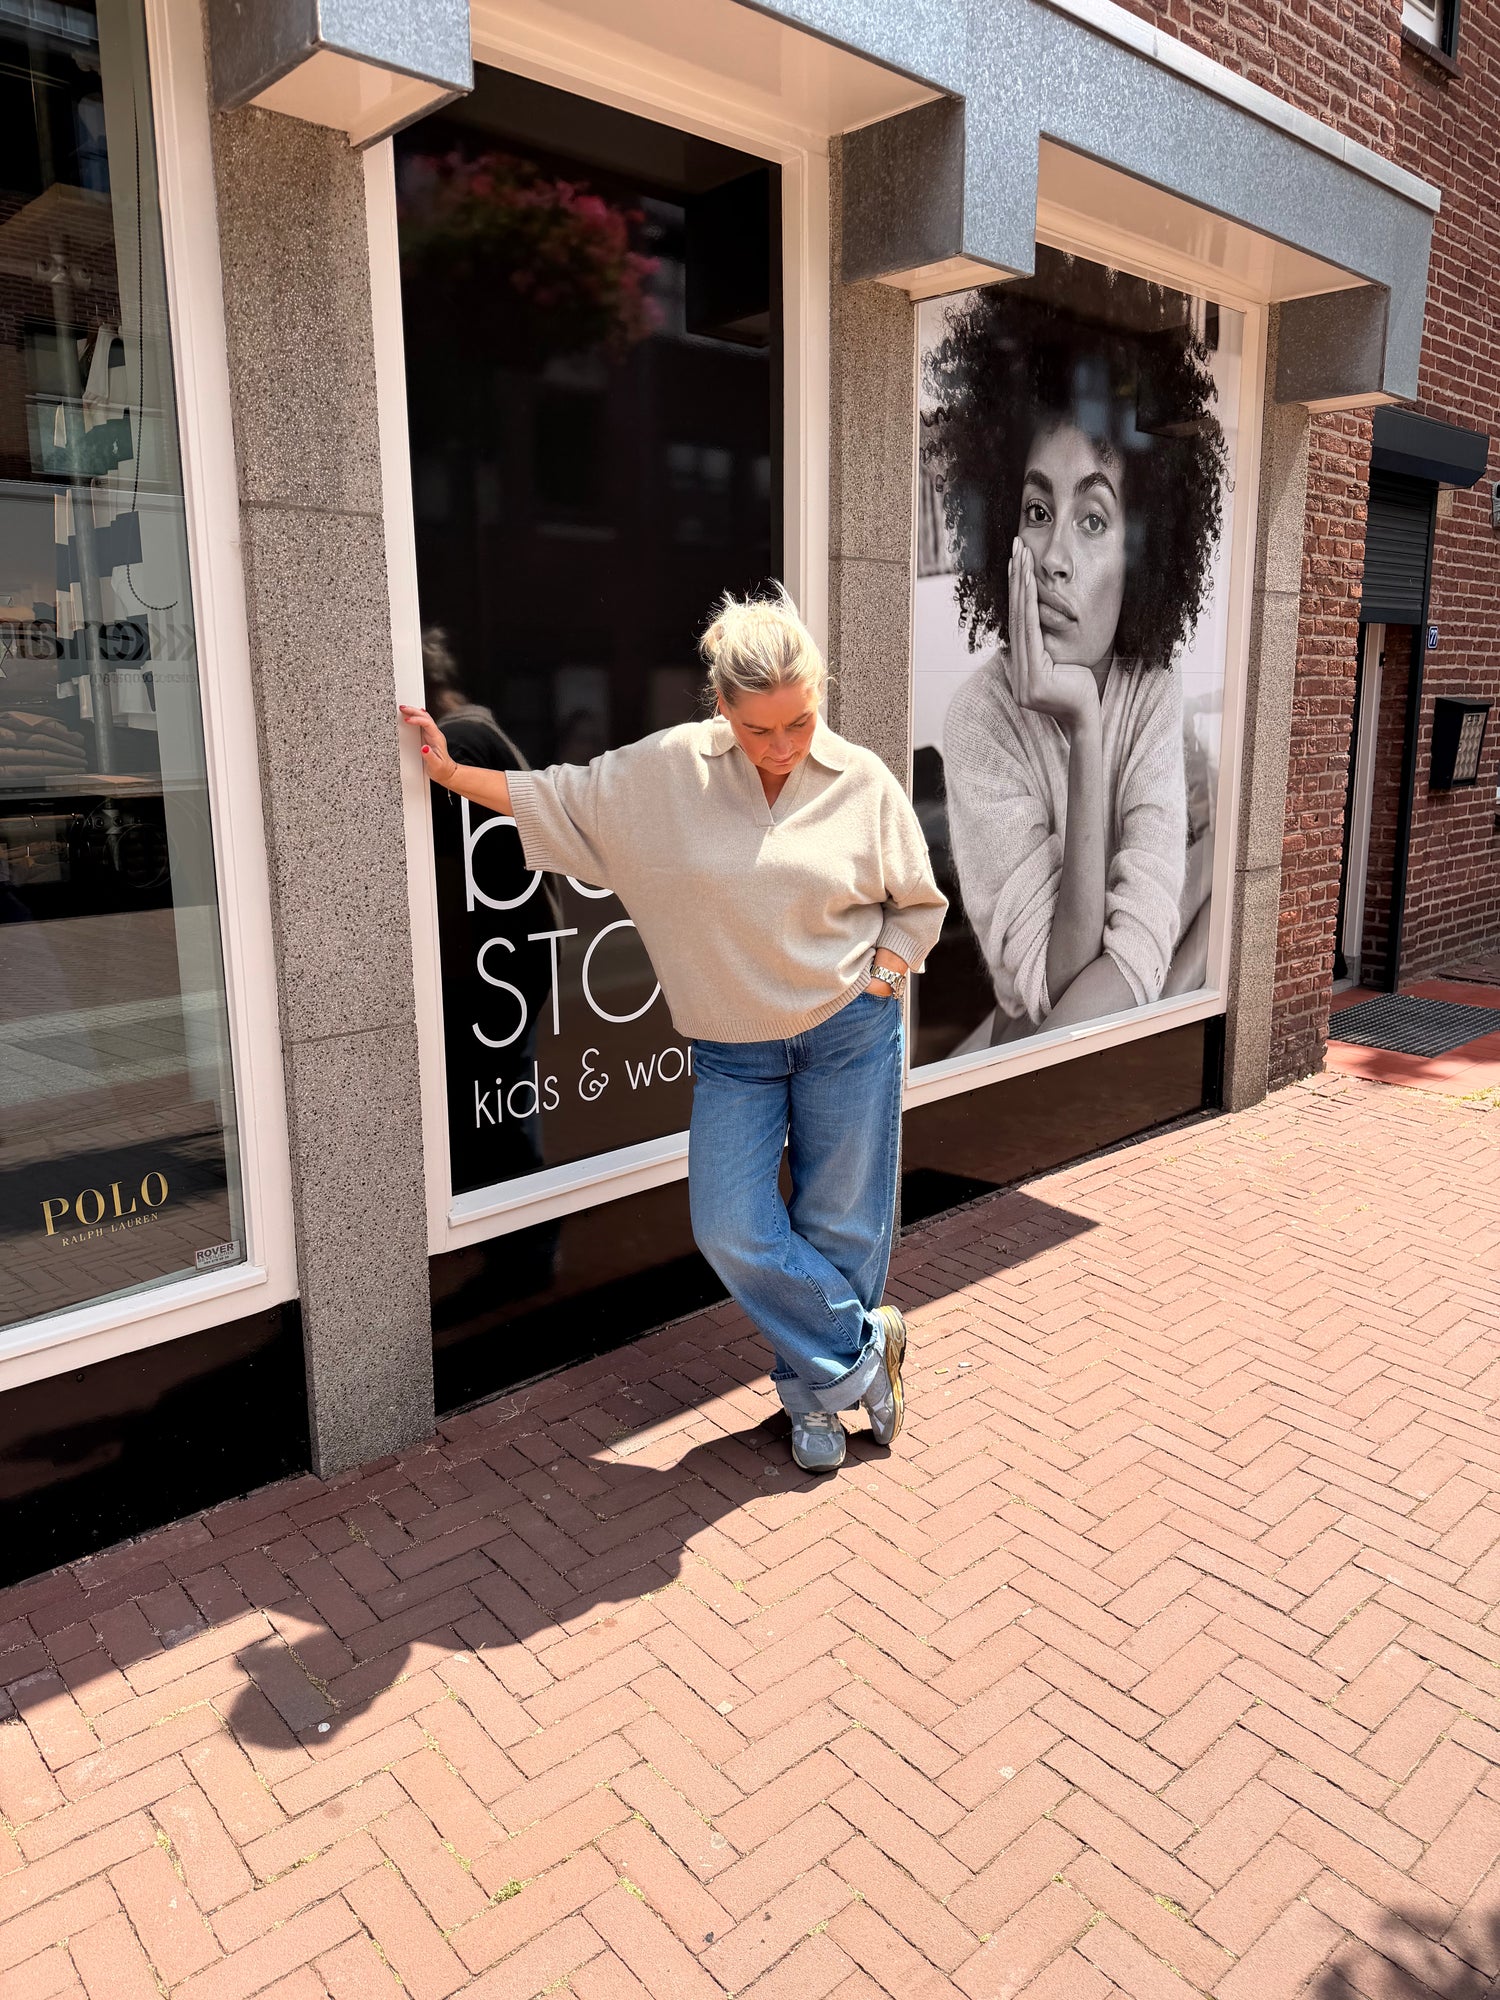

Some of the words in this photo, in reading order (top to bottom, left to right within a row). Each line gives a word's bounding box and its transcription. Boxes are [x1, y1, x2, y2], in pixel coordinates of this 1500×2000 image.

[1429, 629, 1438, 645] 77
[475, 1061, 560, 1129] kids
[578, 1048, 609, 1102] &
[40, 1171, 169, 1237] POLO
[61, 1229, 104, 1247] RALPH
[111, 1212, 159, 1233] LAUREN
[197, 1243, 235, 1260] ROVER
